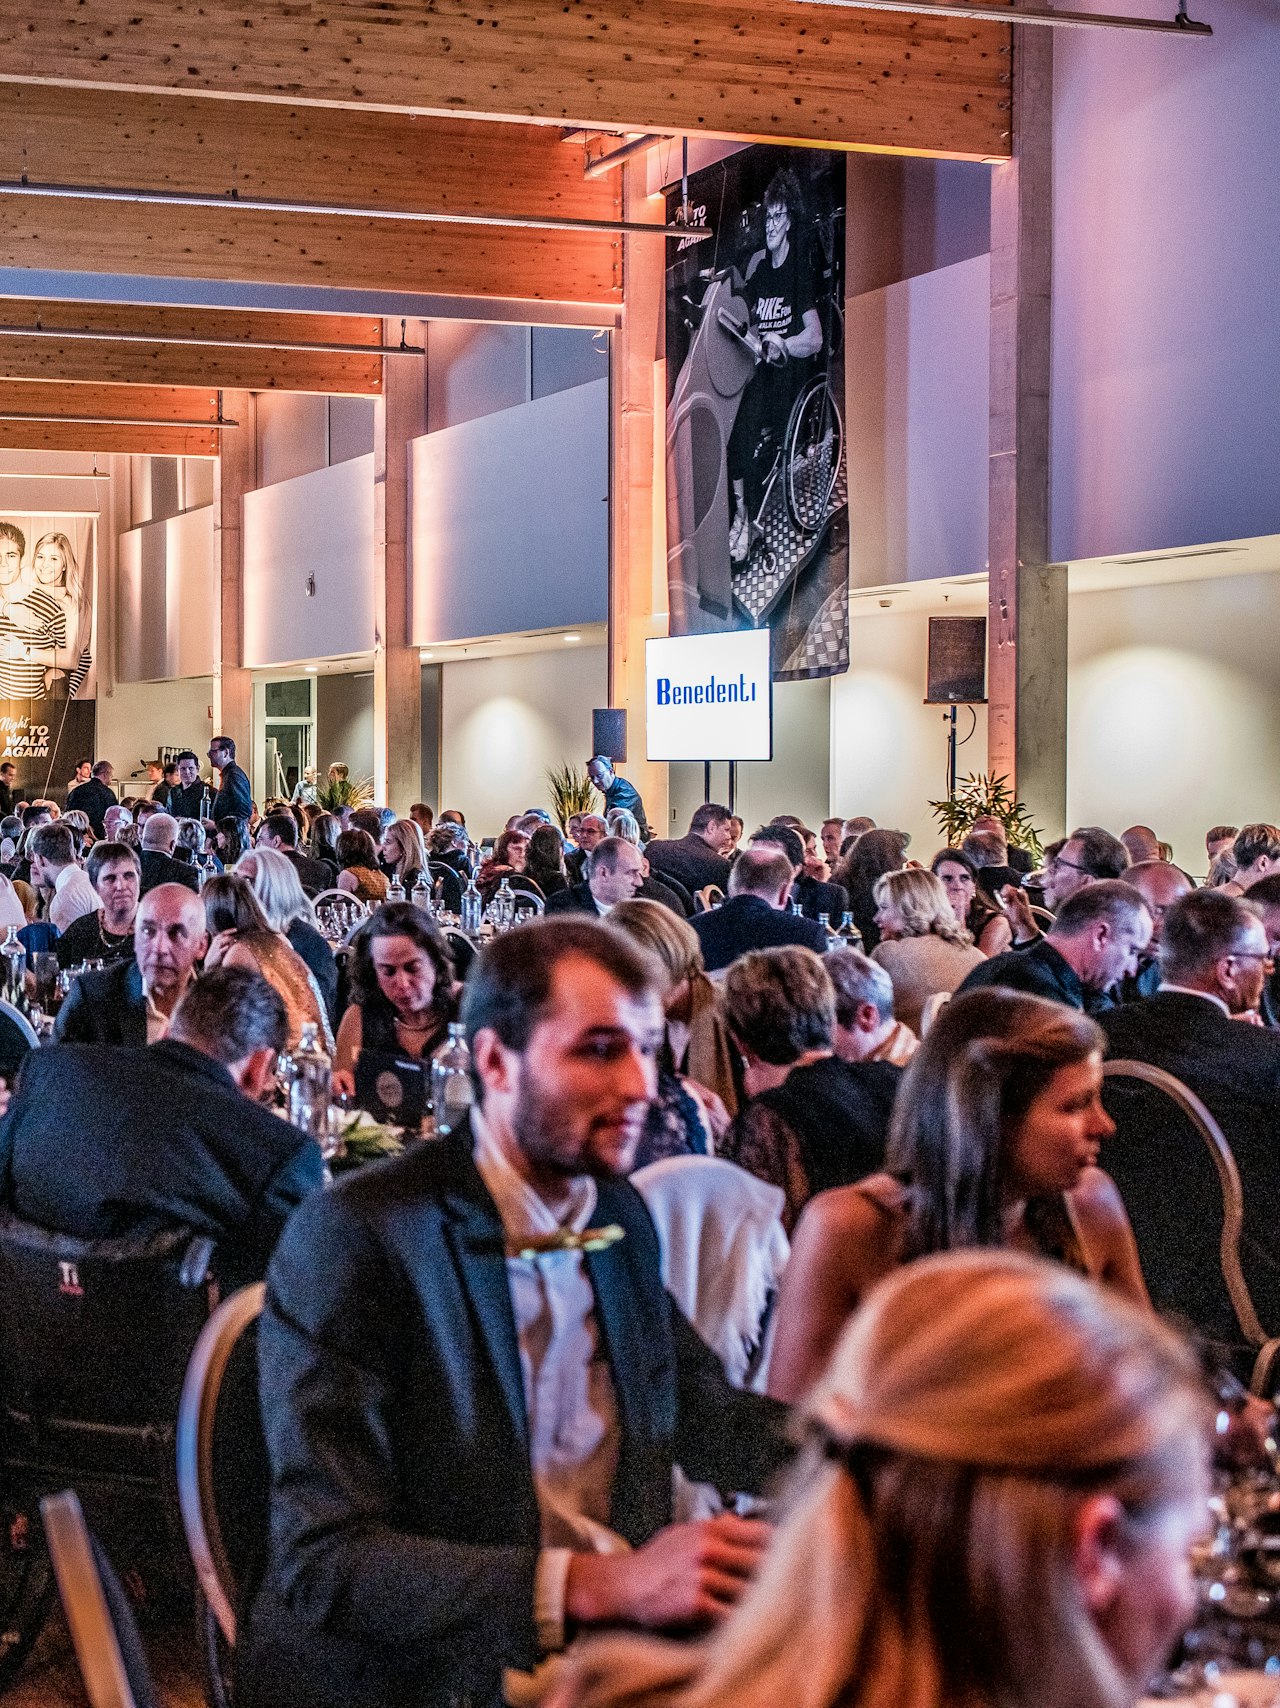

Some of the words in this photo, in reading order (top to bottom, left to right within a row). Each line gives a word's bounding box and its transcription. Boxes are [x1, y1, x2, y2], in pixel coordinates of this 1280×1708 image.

[693, 205, 706, 220] TO
[656, 673, 755, 705] Benedenti
[0, 715, 31, 733] Night
[29, 725, 49, 736] TO
[6, 735, 50, 747] WALK
[1, 746, 50, 757] AGAIN
